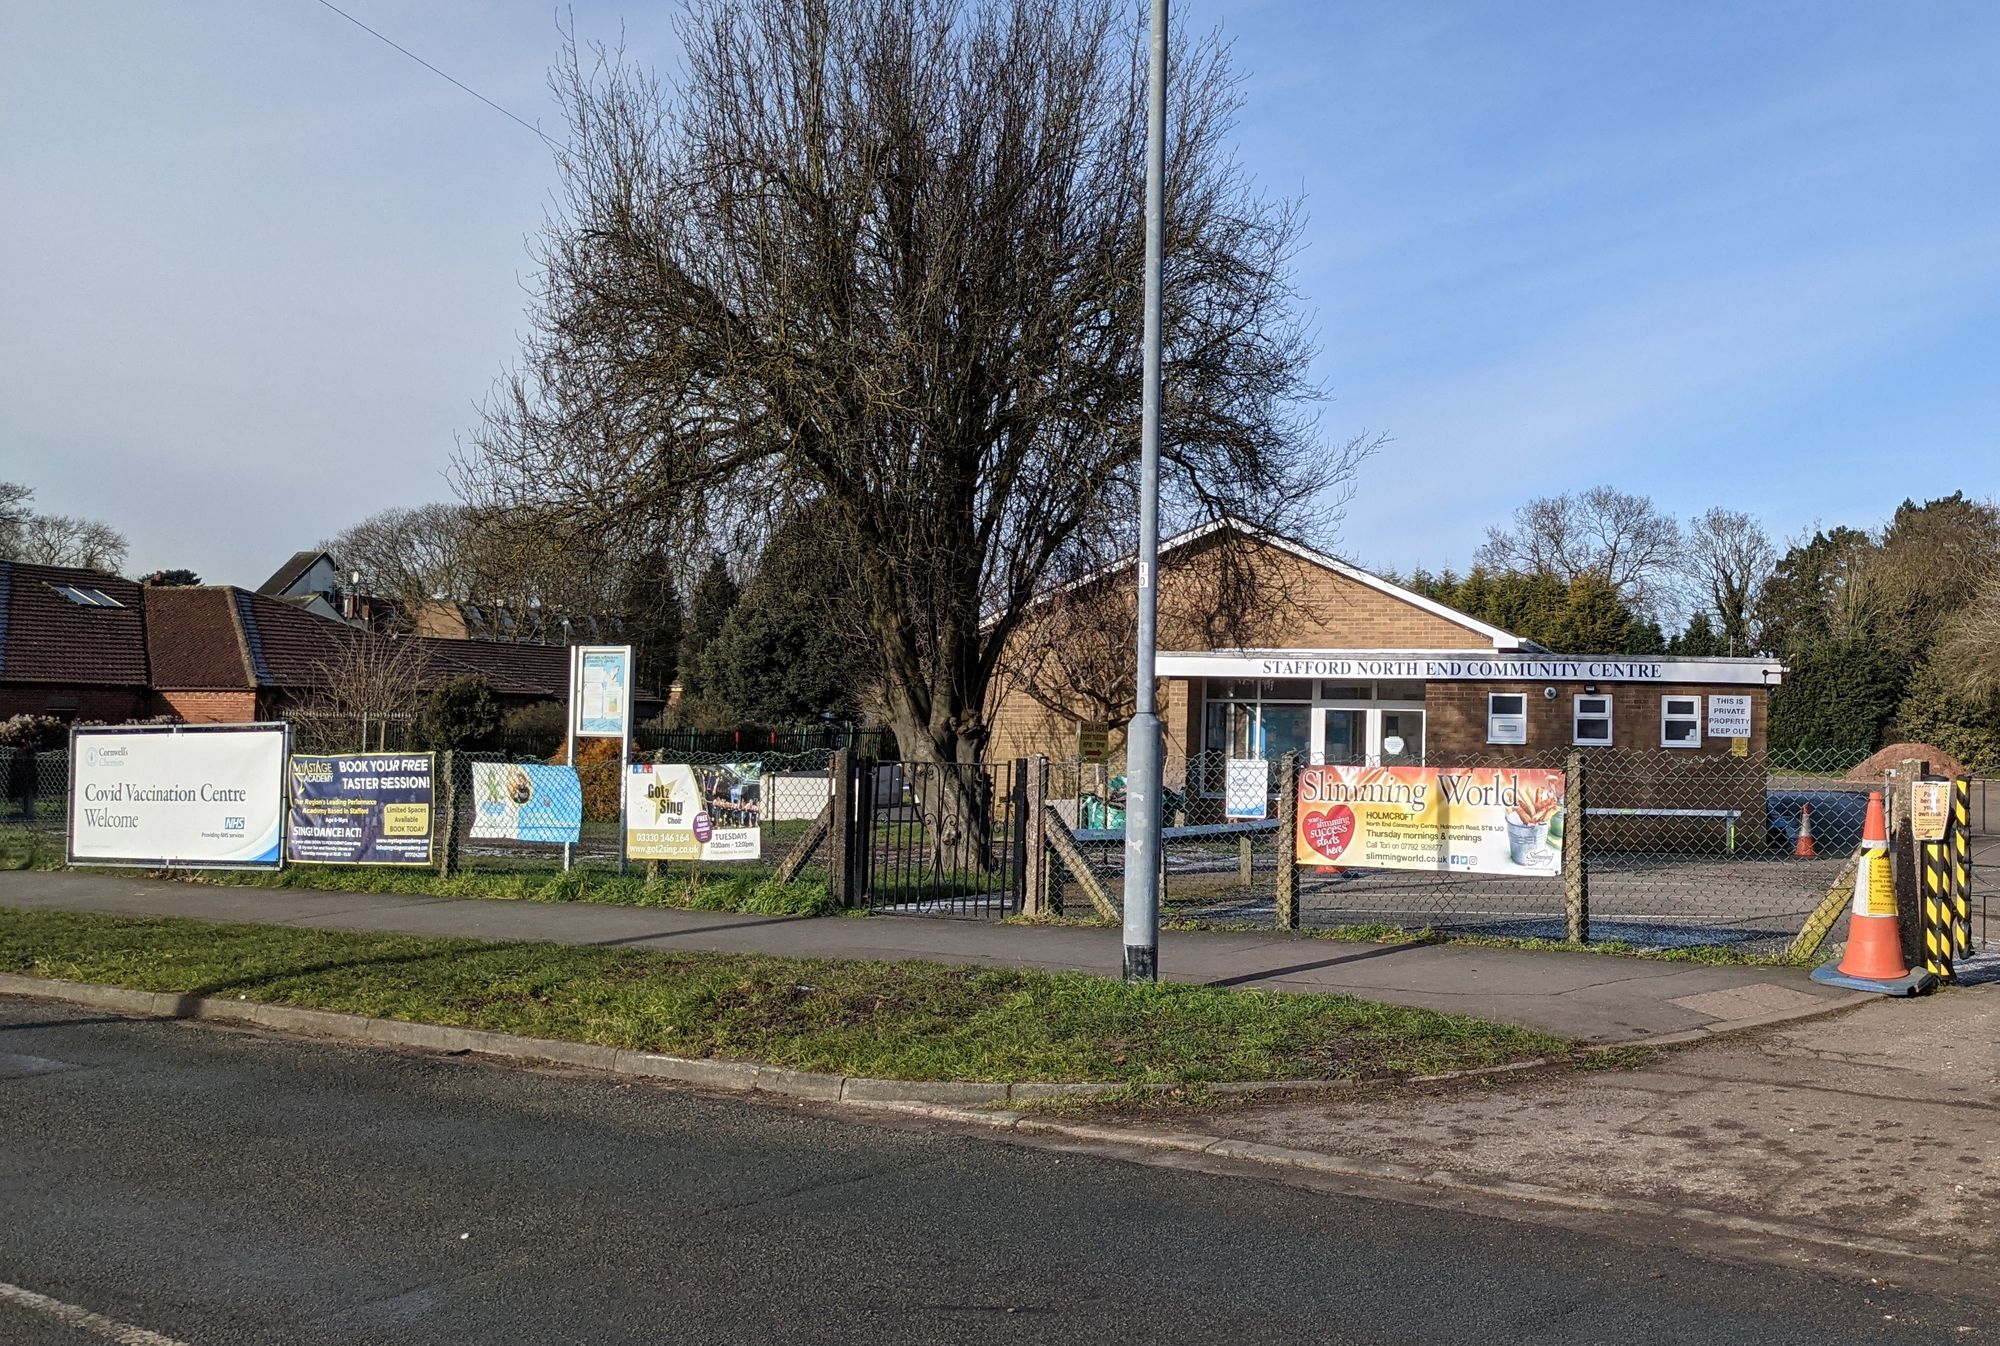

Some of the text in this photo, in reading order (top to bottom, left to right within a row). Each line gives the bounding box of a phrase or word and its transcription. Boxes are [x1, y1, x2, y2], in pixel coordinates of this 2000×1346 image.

[1263, 660, 1661, 678] STAFFORD NORTH END COMMUNITY CENTRE
[339, 760, 428, 772] BOOK YOUR FREE
[342, 777, 430, 789] TASTER SESSION!
[85, 783, 246, 802] Covid Vaccination Centre
[1303, 770, 1427, 811] Slimming
[1437, 775, 1519, 806] World
[660, 799, 683, 815] Sing
[84, 808, 138, 828] Welcome
[1317, 816, 1350, 828] slimming
[1366, 812, 1415, 820] HOLMCROFT
[225, 817, 245, 829] NHS
[293, 827, 362, 837] SING! DANCE! ACT!
[1310, 824, 1348, 838] success
[1366, 829, 1482, 843] Thursday mornings & evenings
[637, 834, 690, 842] 03330 146 164
[1317, 834, 1340, 847] starts
[630, 845, 699, 855] www.got2sing.co.uk
[1326, 845, 1343, 855] here
[1366, 852, 1447, 863] slimmingworld.co.uk
